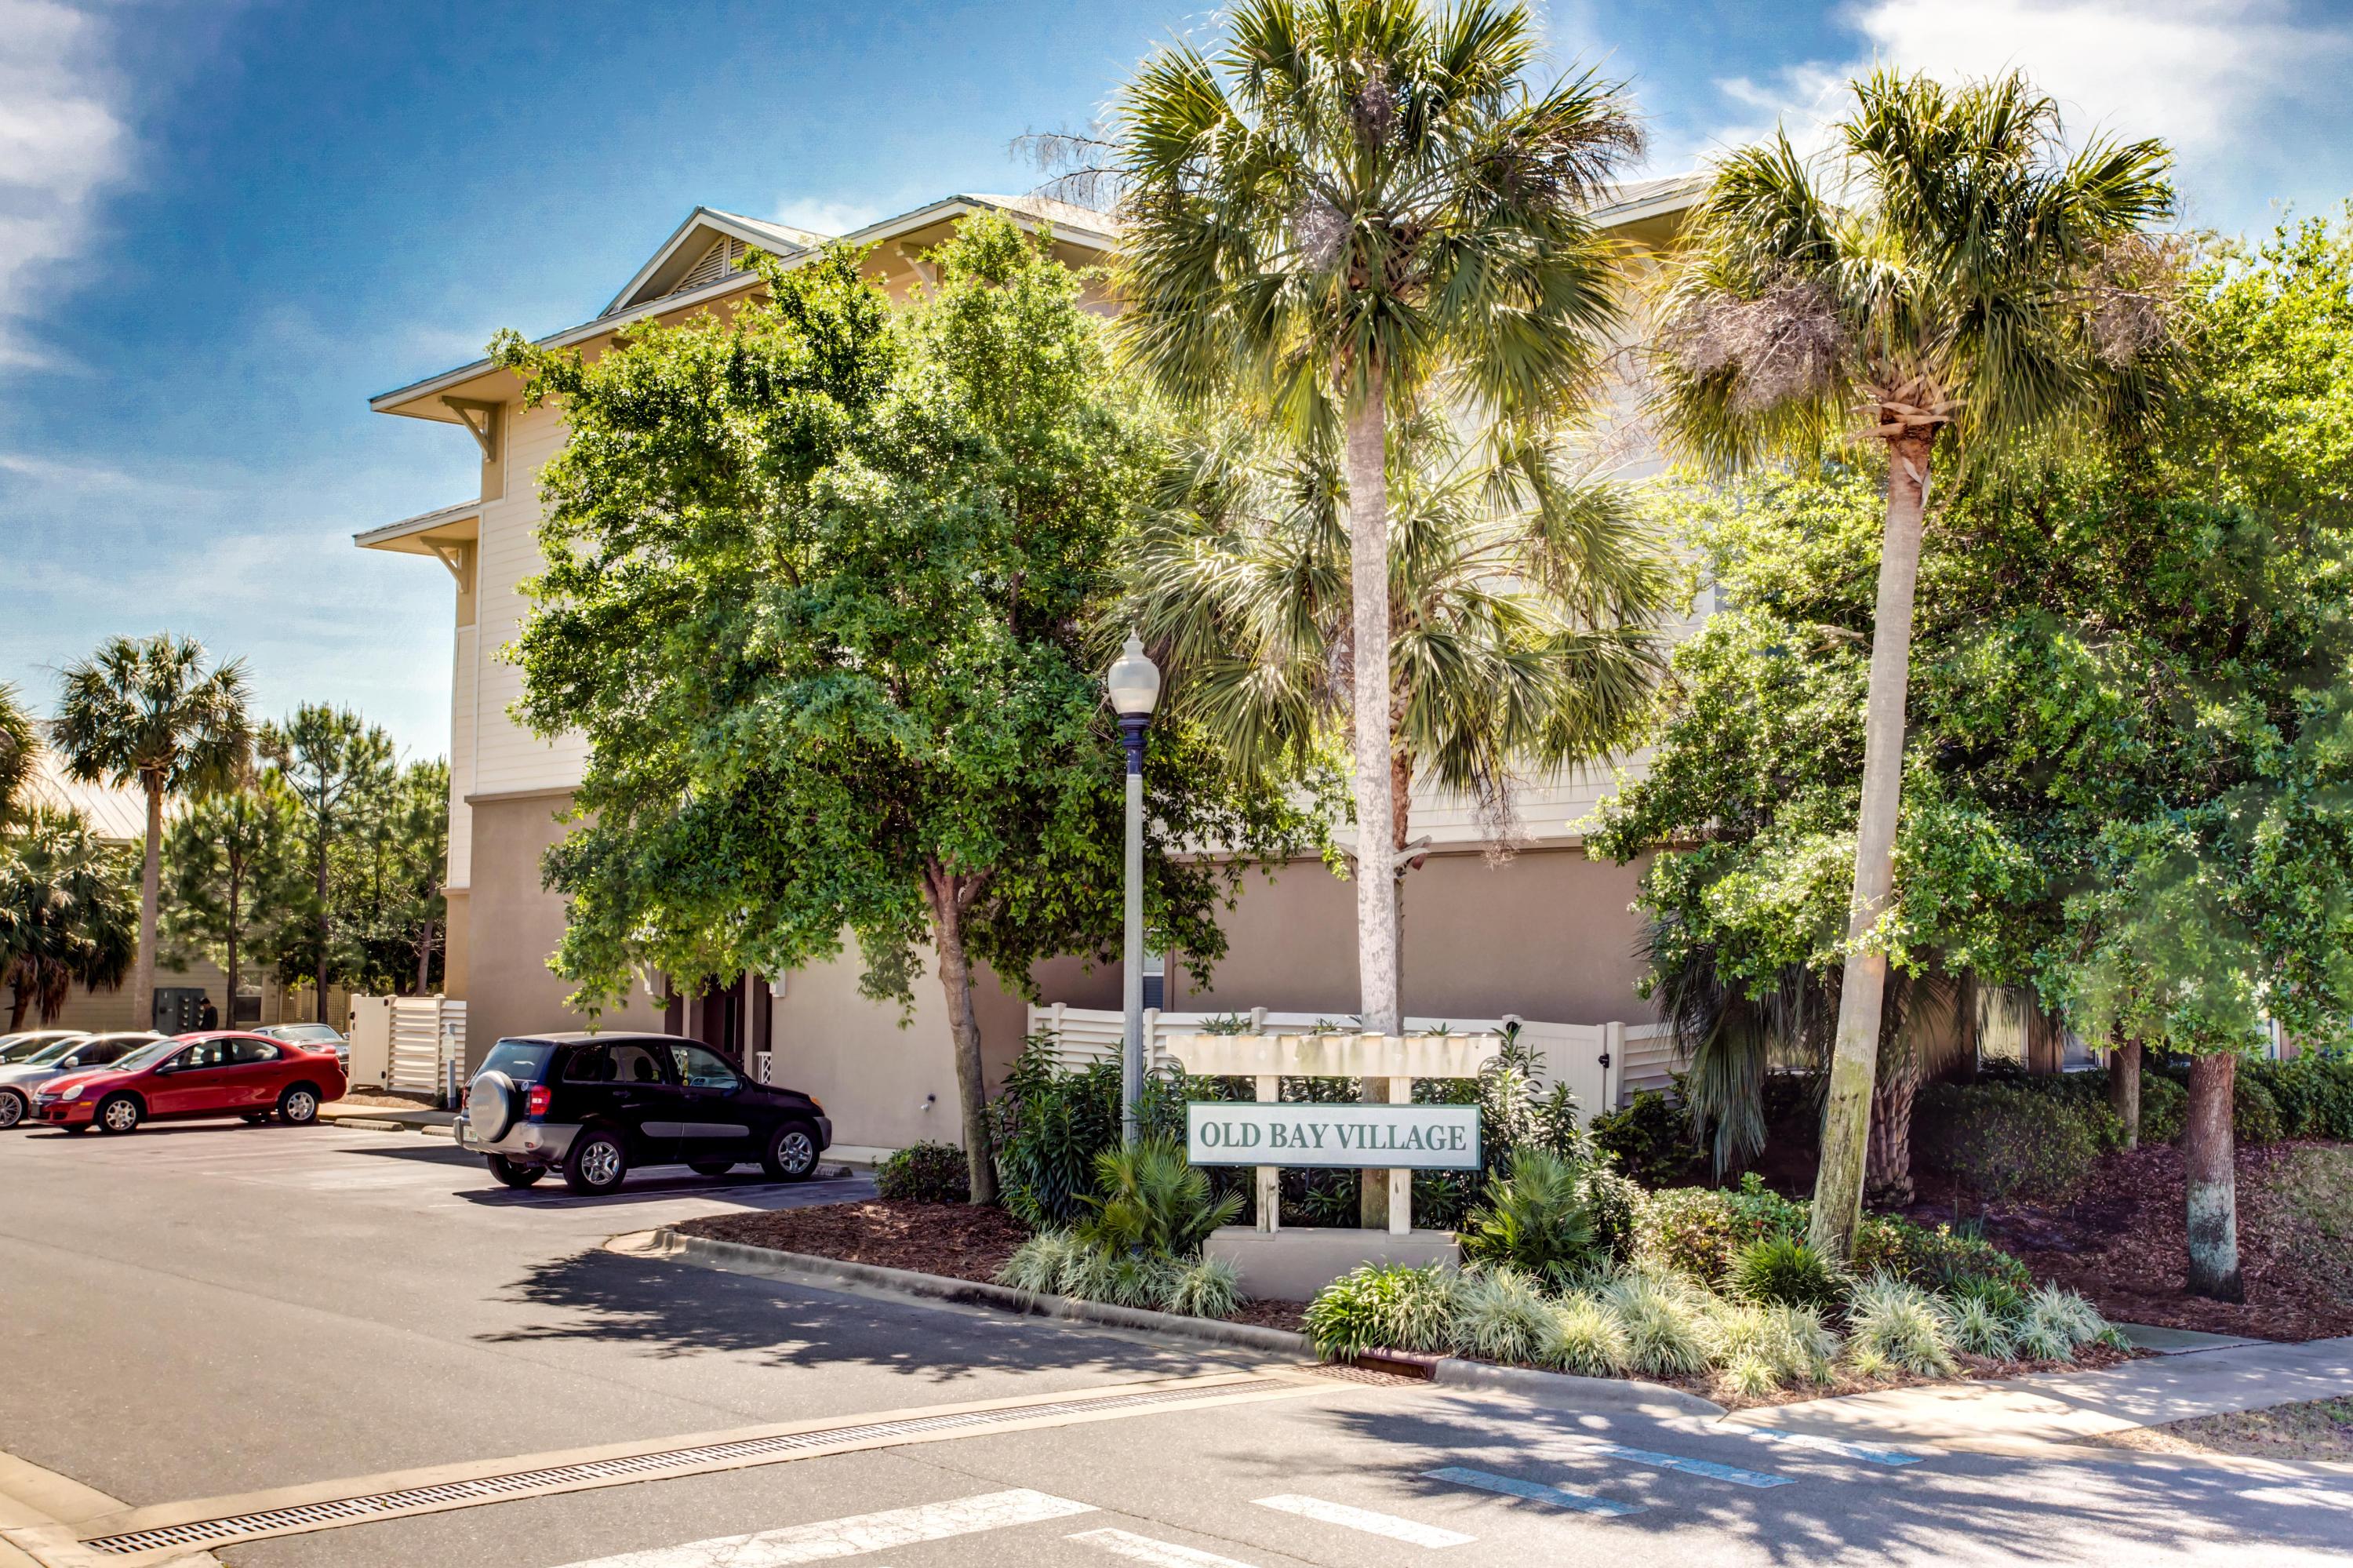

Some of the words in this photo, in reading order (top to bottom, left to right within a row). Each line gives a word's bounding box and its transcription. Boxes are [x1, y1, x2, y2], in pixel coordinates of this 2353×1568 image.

[1200, 1122, 1261, 1148] OLD
[1268, 1122, 1329, 1149] BAY
[1333, 1123, 1467, 1151] VILLAGE
